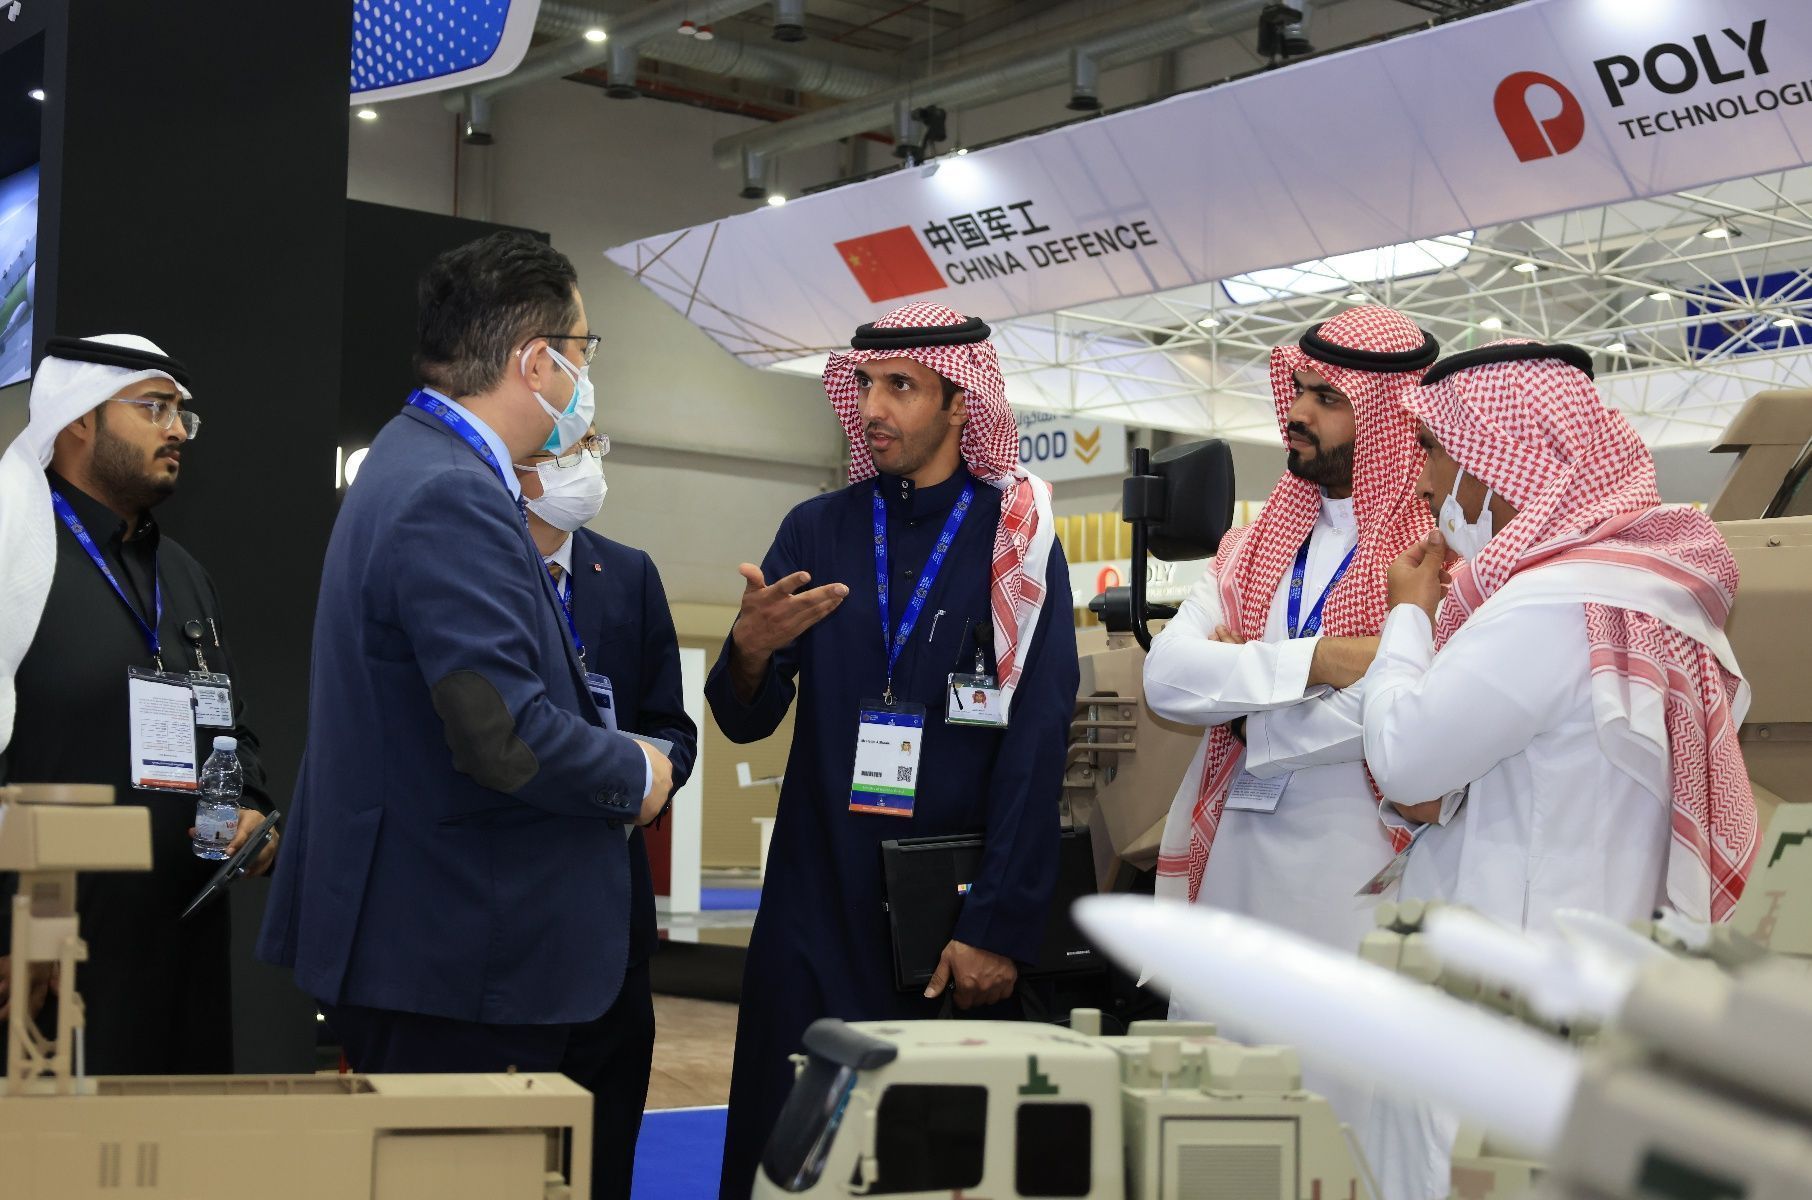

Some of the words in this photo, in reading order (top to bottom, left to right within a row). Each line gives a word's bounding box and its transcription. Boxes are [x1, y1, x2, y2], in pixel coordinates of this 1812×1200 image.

[1593, 19, 1769, 108] POLY
[1618, 79, 1812, 139] TECHNOLOGI
[922, 200, 1050, 254] 中国军工
[945, 251, 1025, 285] CHINA
[1027, 221, 1157, 268] DEFENCE
[1019, 431, 1067, 464] OOD
